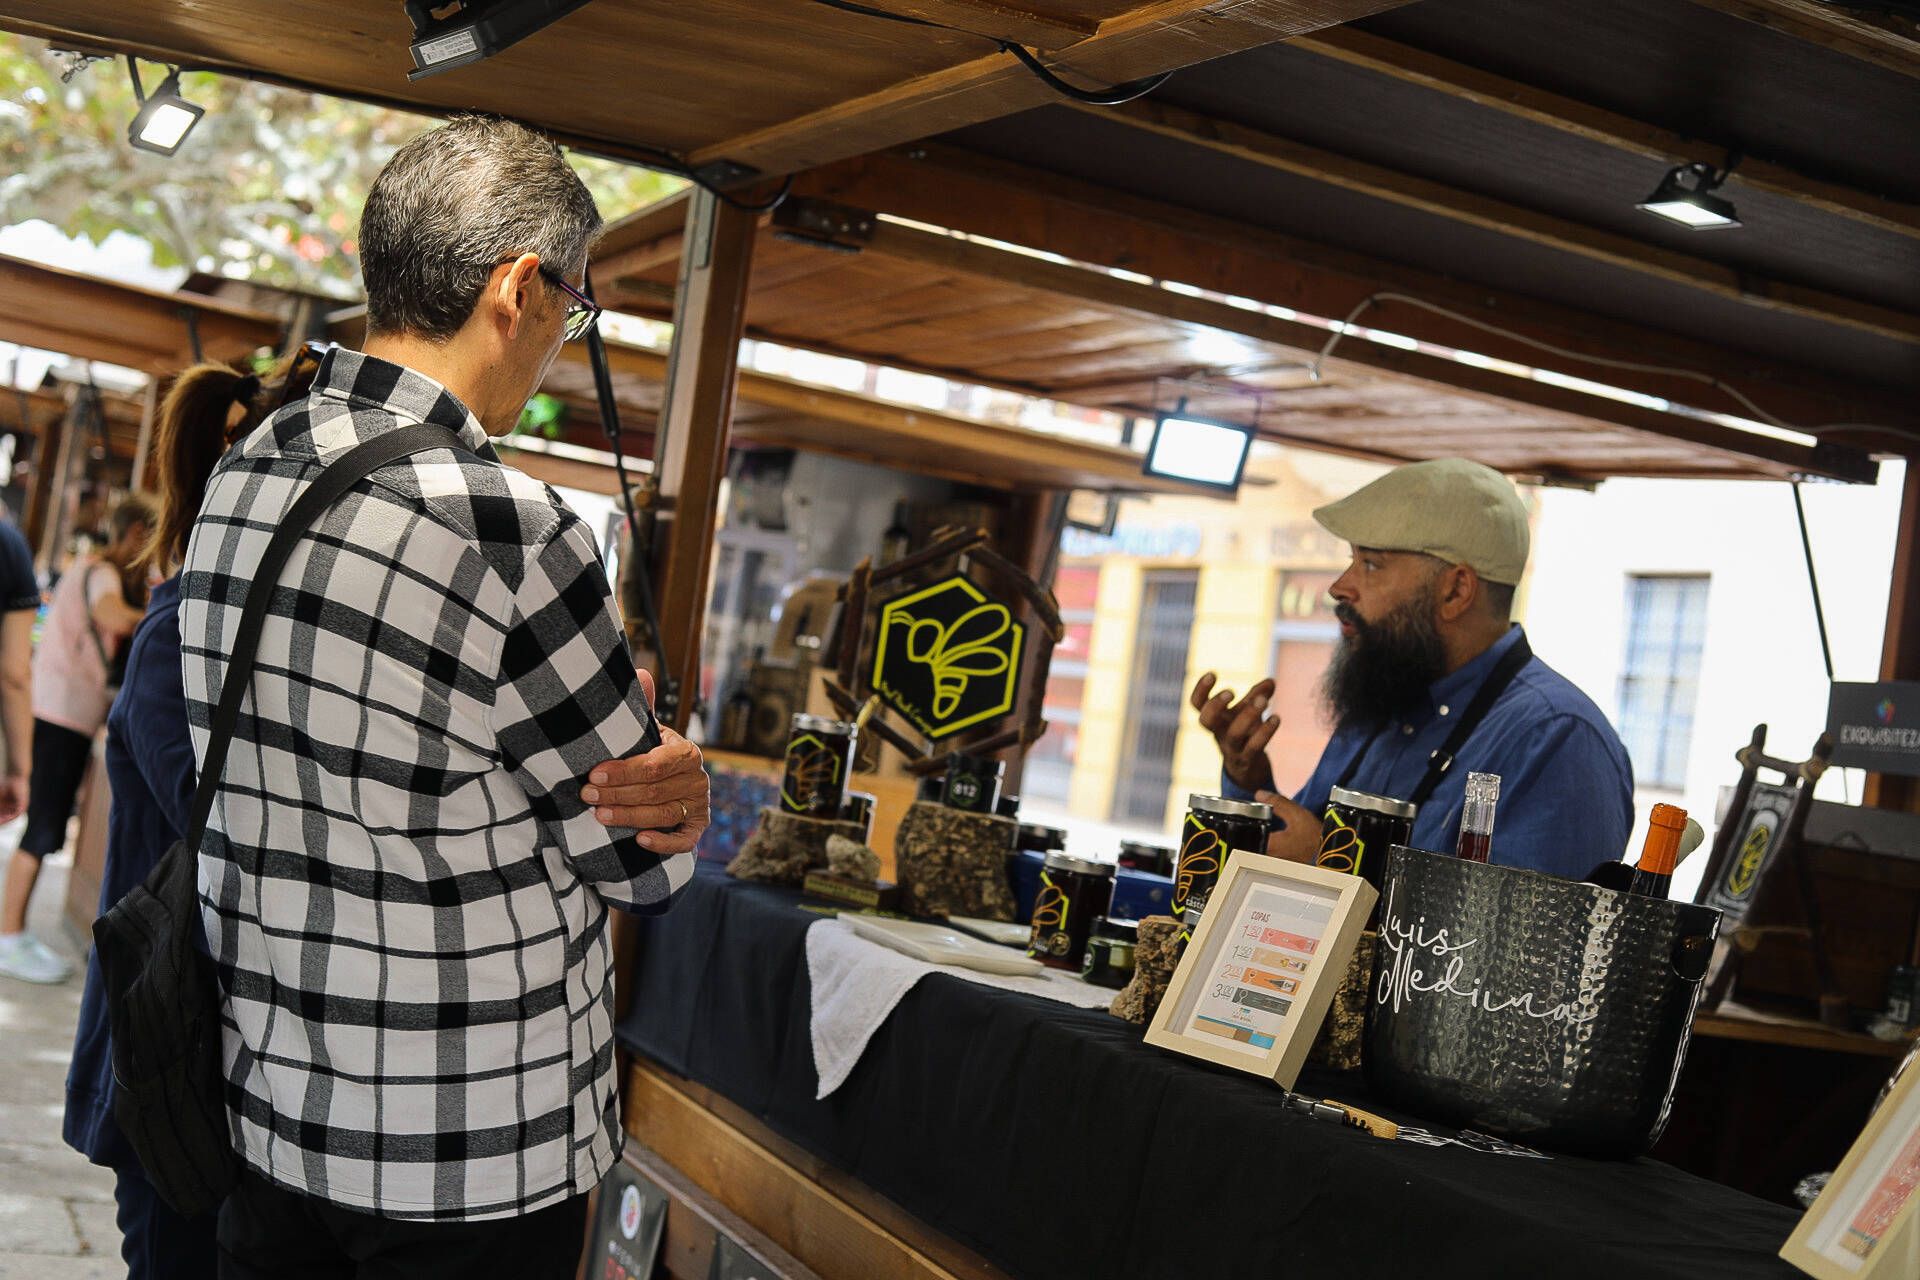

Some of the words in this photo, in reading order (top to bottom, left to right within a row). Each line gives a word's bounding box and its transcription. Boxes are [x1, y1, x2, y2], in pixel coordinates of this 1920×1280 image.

[1841, 725, 1920, 747] EXQUISITEZ
[1250, 911, 1271, 923] COPAS
[1377, 878, 1478, 955] Luis
